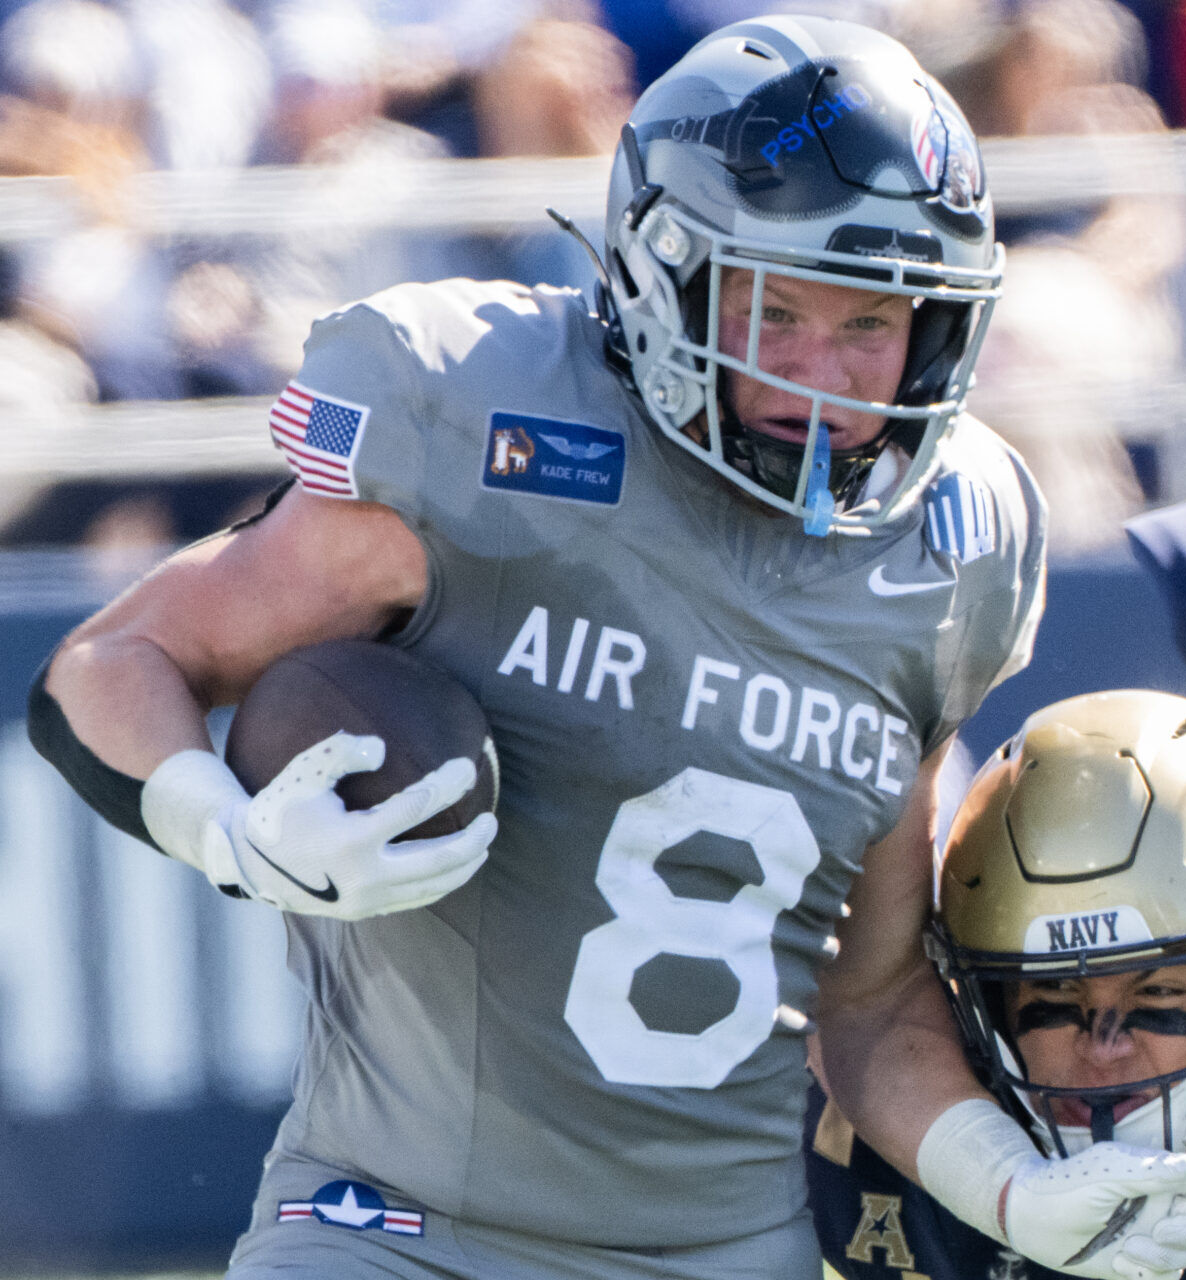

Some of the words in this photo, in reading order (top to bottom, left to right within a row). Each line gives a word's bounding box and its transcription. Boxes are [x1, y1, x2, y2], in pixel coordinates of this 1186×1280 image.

[760, 84, 868, 168] PSYCHO
[540, 464, 573, 480] KADE
[576, 469, 610, 485] FREW
[498, 605, 647, 710] AIR
[681, 655, 909, 796] FORCE
[564, 767, 822, 1090] 8
[1046, 911, 1118, 952] NAVY
